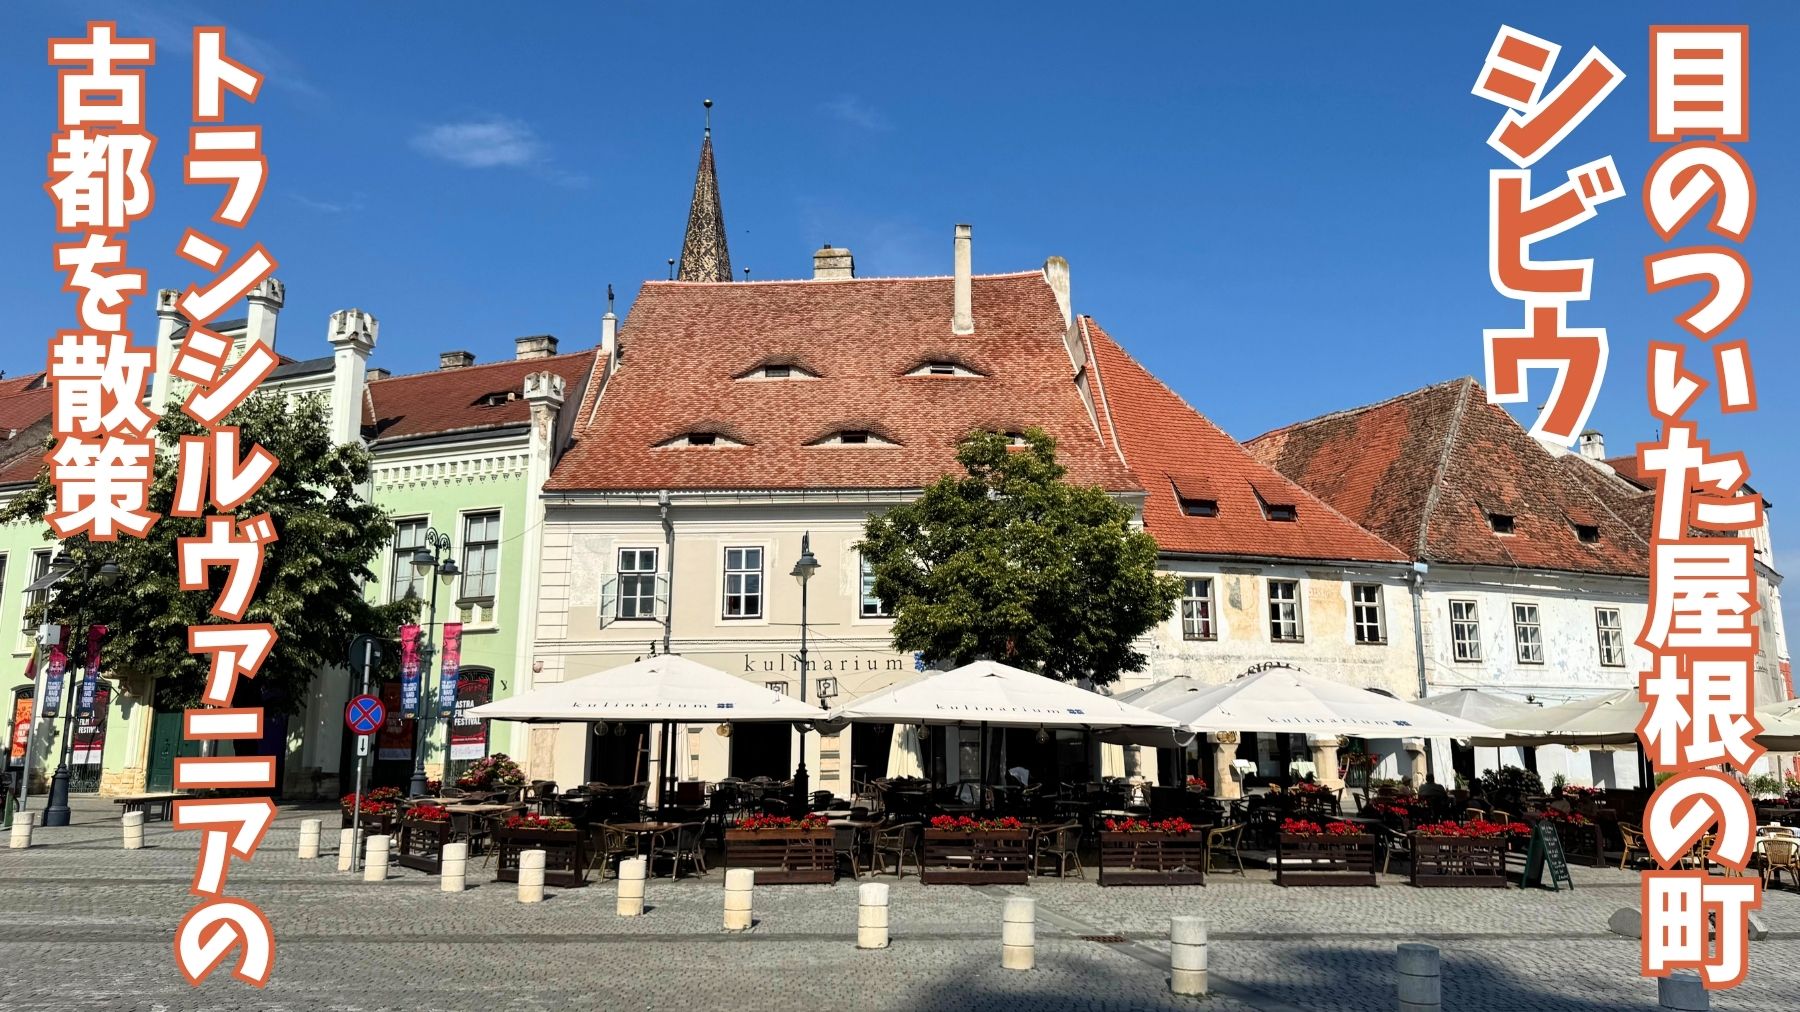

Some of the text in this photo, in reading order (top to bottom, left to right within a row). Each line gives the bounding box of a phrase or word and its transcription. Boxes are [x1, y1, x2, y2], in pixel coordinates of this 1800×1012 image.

[744, 653, 904, 672] kulinarium
[455, 700, 474, 708] ASTRA
[573, 701, 707, 709] kulinarium
[454, 717, 481, 727] FESTIVAL
[1267, 716, 1389, 727] kulinarium
